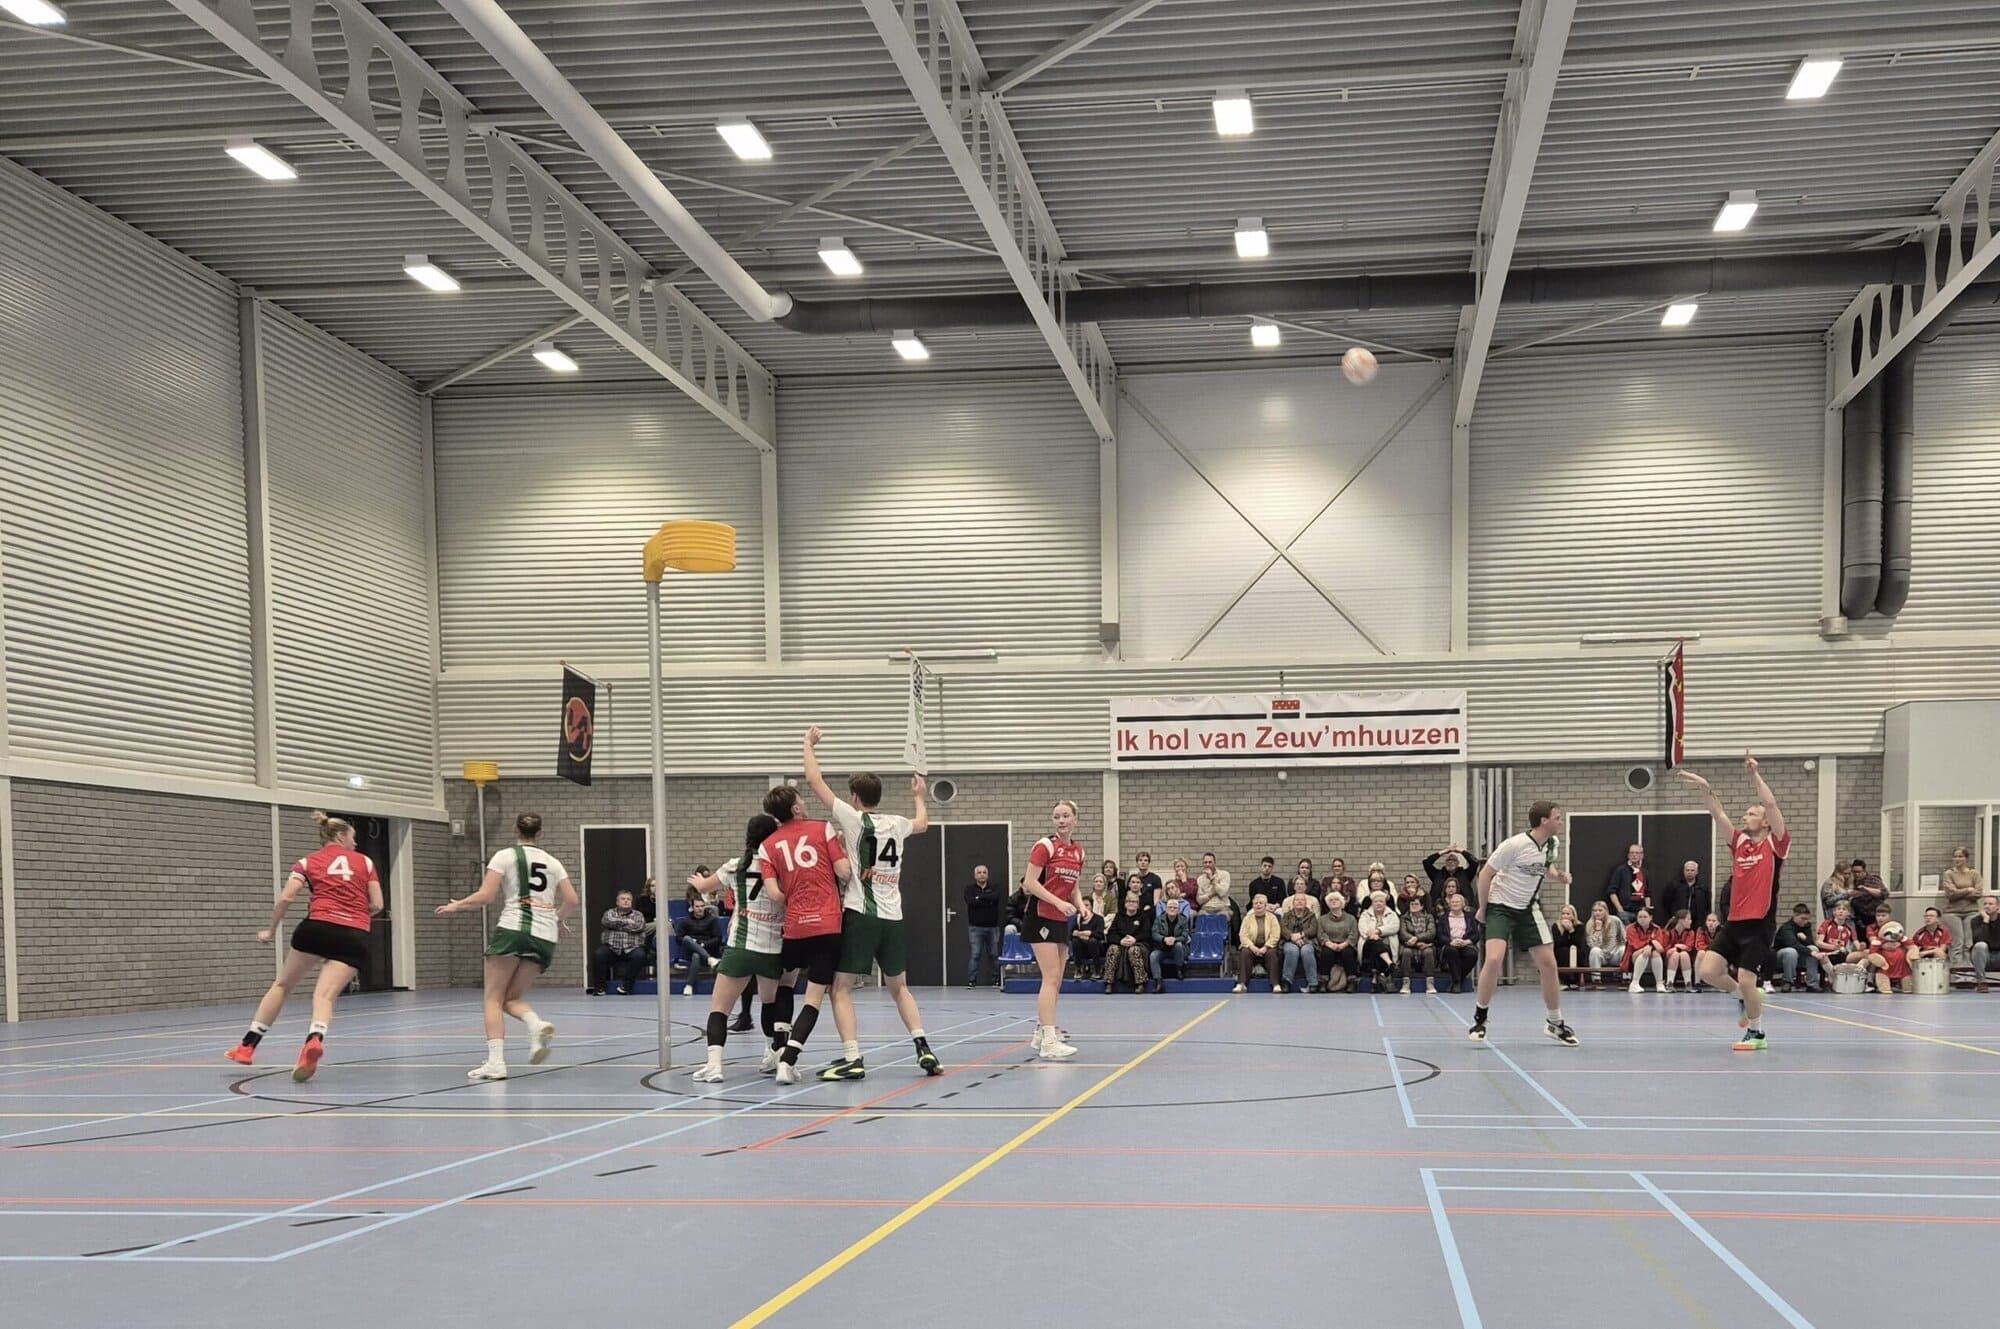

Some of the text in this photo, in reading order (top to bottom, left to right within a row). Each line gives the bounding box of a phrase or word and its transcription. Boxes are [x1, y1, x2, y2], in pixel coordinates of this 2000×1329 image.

[1117, 729, 1139, 751] Ik
[1149, 728, 1189, 750] hol
[1199, 732, 1246, 749] van
[775, 835, 818, 872] 16
[868, 838, 899, 867] 14
[1057, 847, 1065, 857] 2
[327, 855, 355, 881] 4
[528, 862, 548, 893] 5
[745, 872, 764, 901] 7
